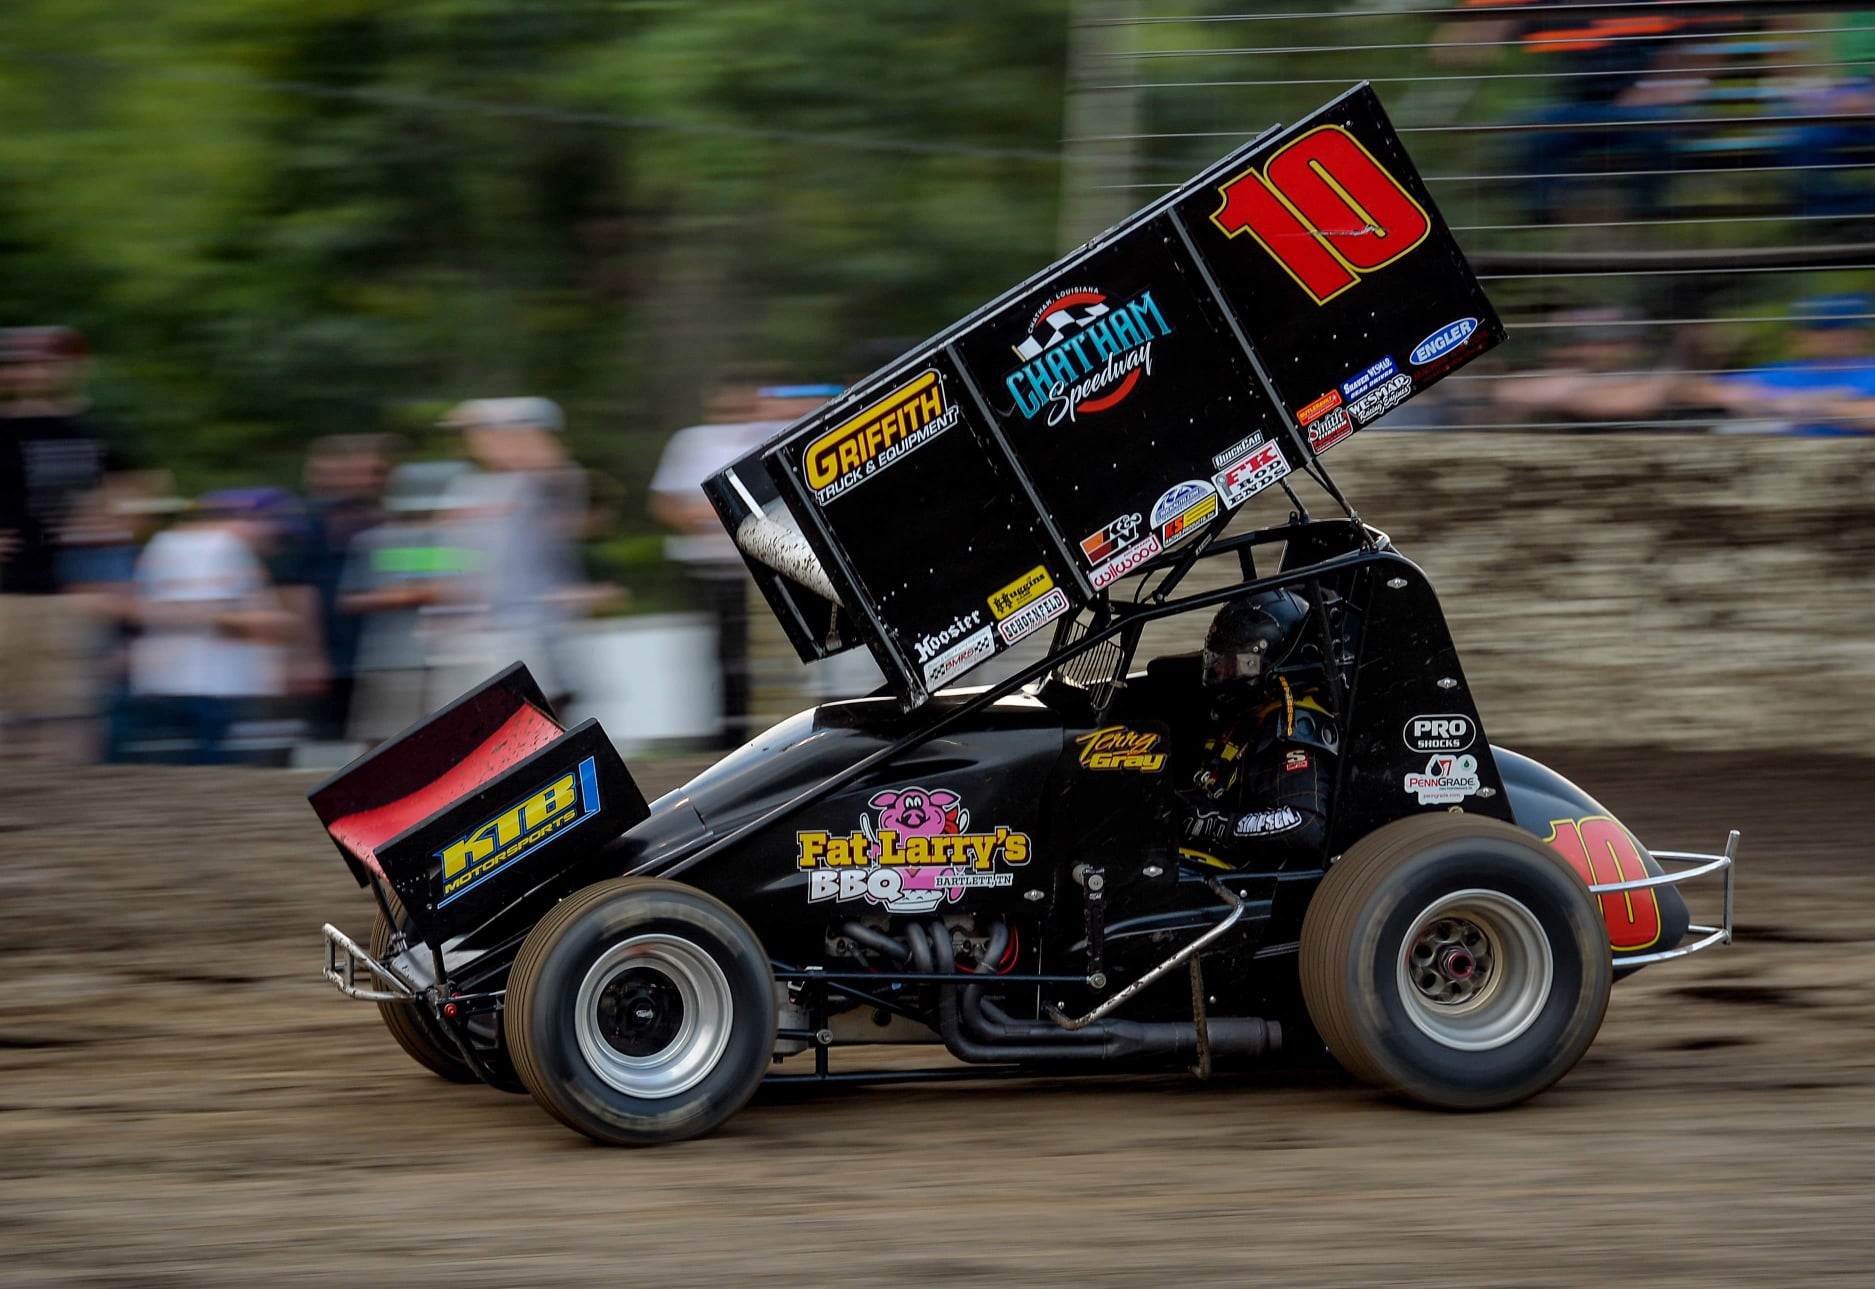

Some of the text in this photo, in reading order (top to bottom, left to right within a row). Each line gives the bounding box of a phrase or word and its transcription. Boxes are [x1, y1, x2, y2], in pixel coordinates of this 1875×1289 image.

[1209, 124, 1431, 306] 10
[1055, 285, 1099, 300] LOUISIANA
[1006, 290, 1172, 420] CHATHAM
[1416, 321, 1472, 361] ENGLER
[1047, 341, 1153, 427] Speedway
[1347, 375, 1411, 417] WESMAR
[806, 372, 942, 490] GRIFFITH
[1308, 407, 1344, 442] Smith
[817, 409, 957, 502] TRUCK & EQUIPMENT
[1226, 446, 1278, 487] FK
[1237, 460, 1282, 490] ROD
[1229, 466, 1286, 505] ENDS
[1102, 513, 1142, 551] K&N
[1094, 537, 1159, 587] wilwood
[992, 573, 1045, 614] Huggins
[914, 609, 981, 664] Hoosier
[1004, 594, 1063, 638] SCHOENFELD
[1414, 720, 1467, 738] PRO
[1418, 739, 1460, 749] SHOCKS
[1089, 752, 1165, 770] Gray
[444, 809, 577, 894] MOTORSPORTS
[799, 828, 1029, 870] Fat Larry's
[810, 868, 905, 901] BBQ
[1542, 815, 1661, 952] 10
